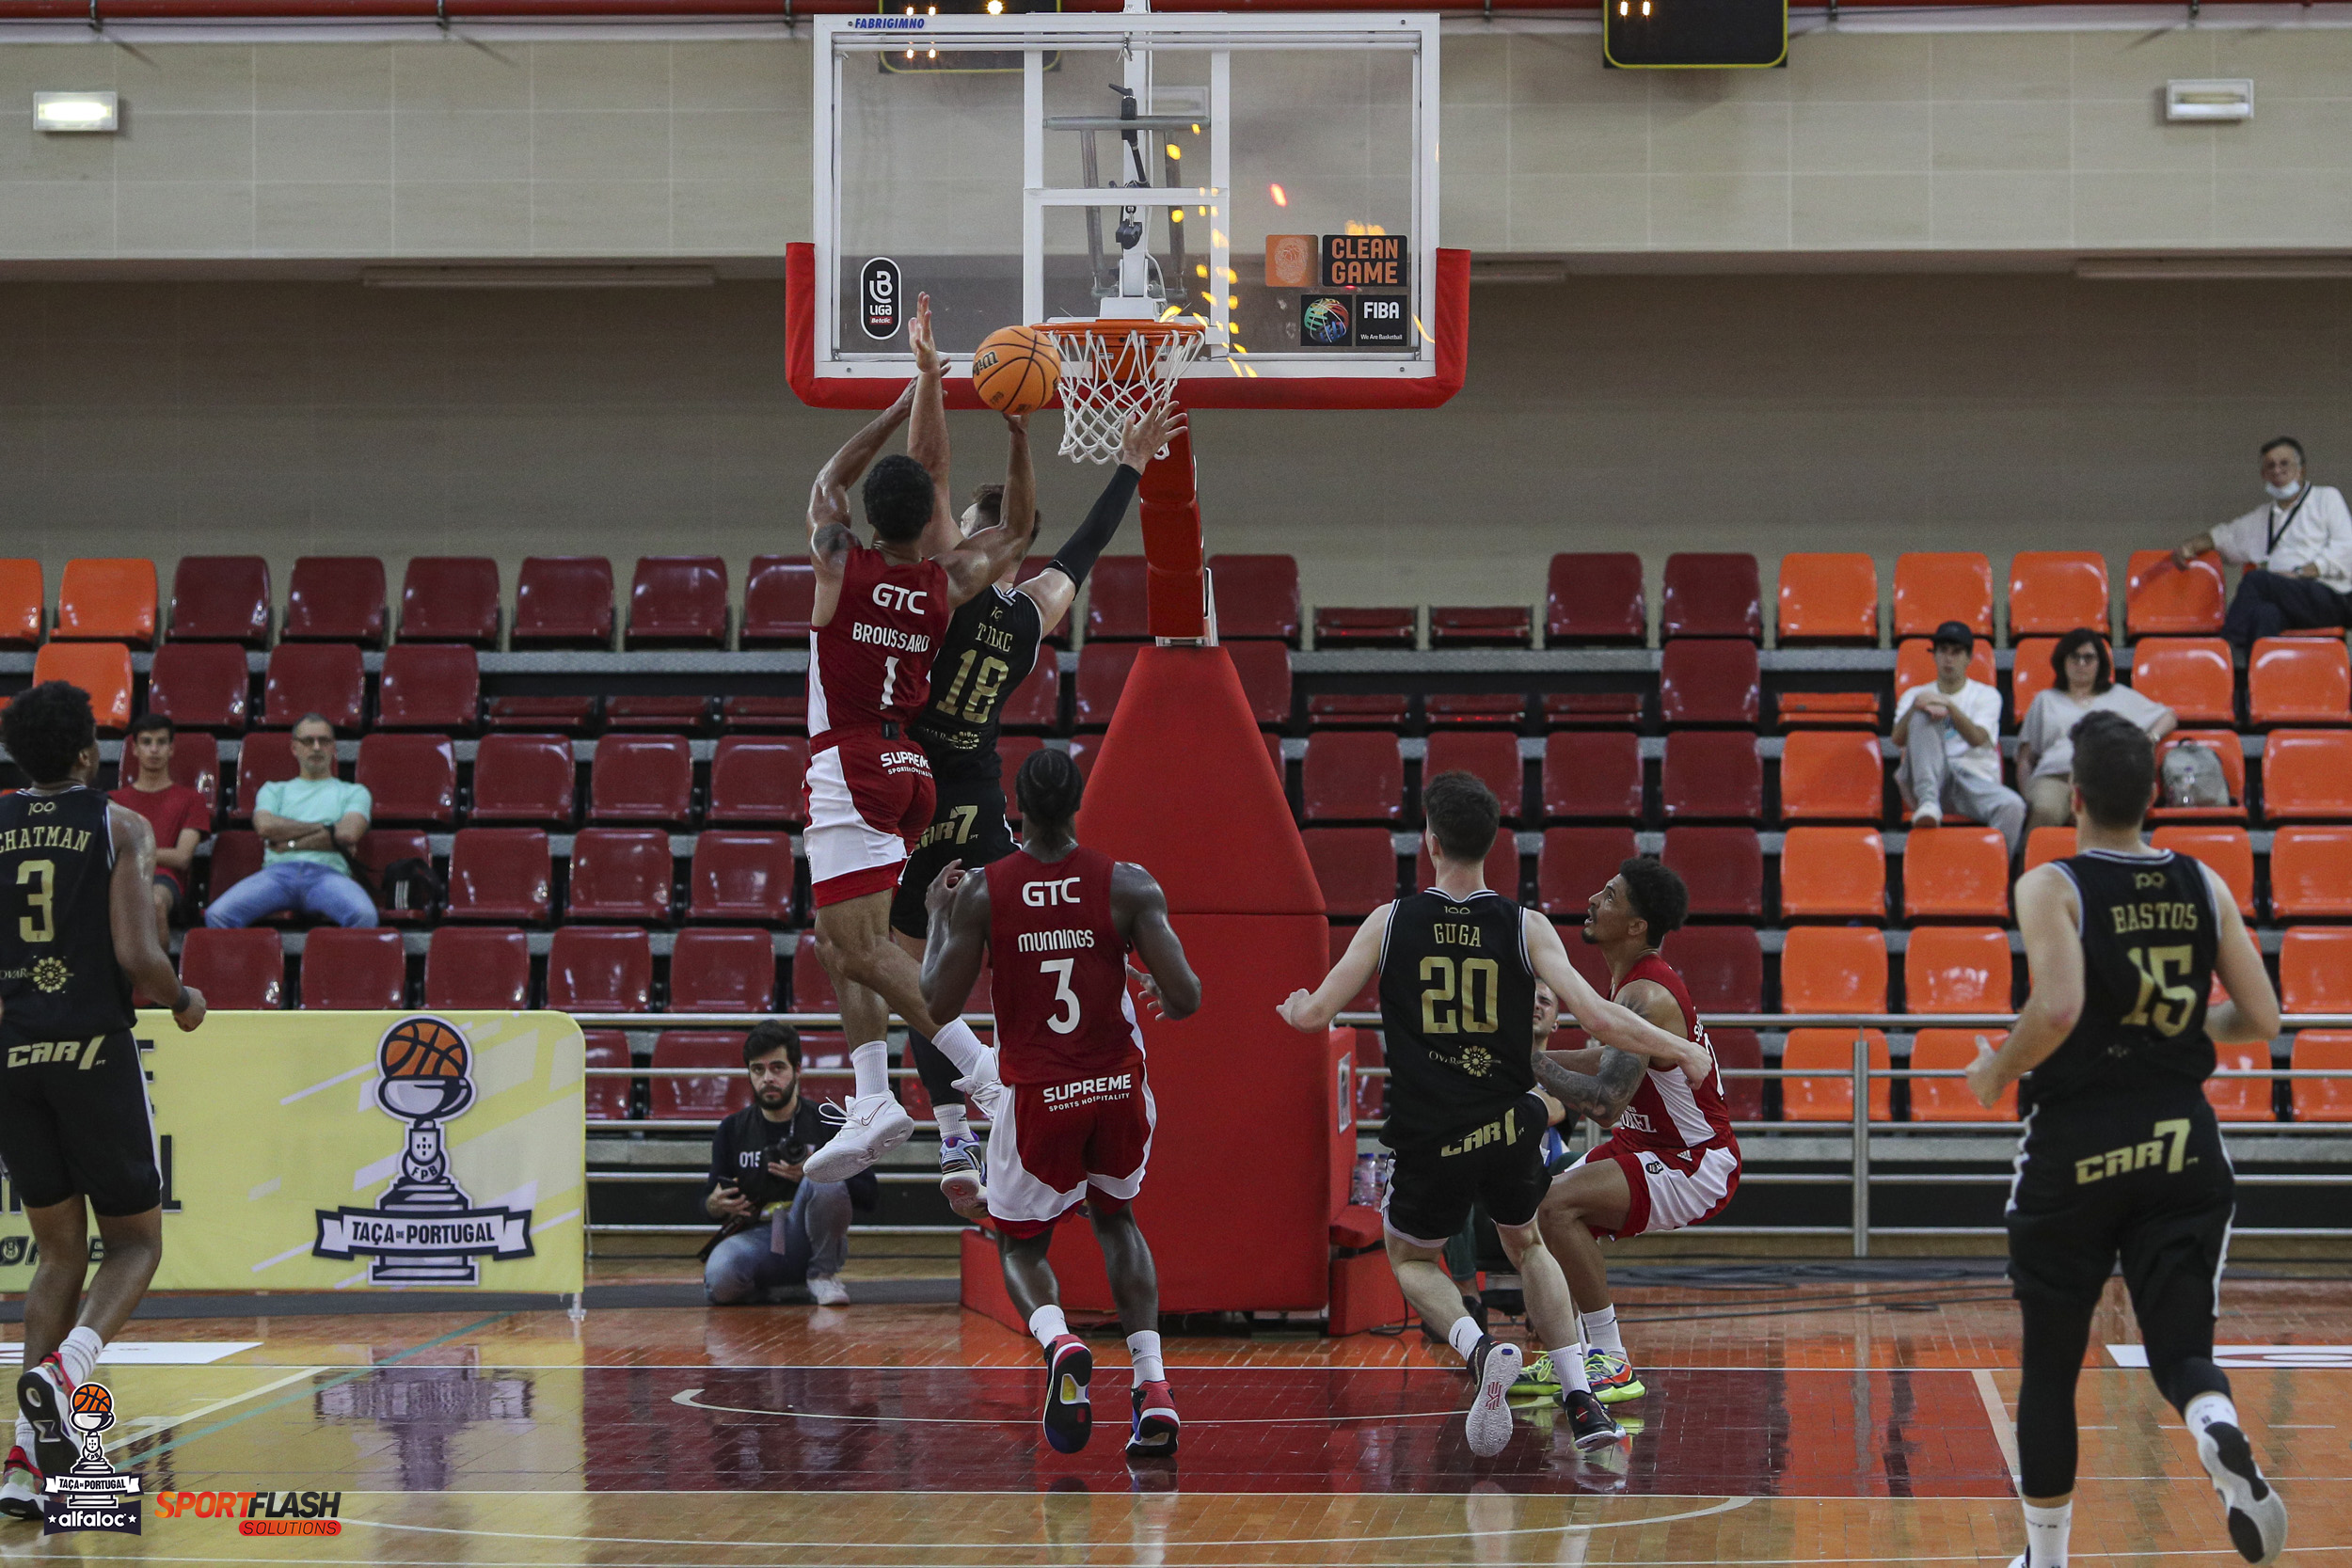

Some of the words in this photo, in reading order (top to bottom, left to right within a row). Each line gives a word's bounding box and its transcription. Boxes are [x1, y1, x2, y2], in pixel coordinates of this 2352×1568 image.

[855, 18, 925, 28] FABRIGIMNO
[1331, 238, 1399, 259] CLEAN
[1331, 261, 1398, 284] GAME
[1363, 301, 1400, 319] FIBA
[872, 582, 928, 615] GTC
[852, 622, 930, 653] BROUSSARD
[880, 656, 899, 710] 1
[935, 649, 1009, 724] 18
[880, 751, 930, 769] SUPREM
[16, 859, 55, 942] 3
[1022, 877, 1081, 907] GTC
[2110, 902, 2199, 935] BASTOS
[1434, 923, 1482, 947] GUGA
[1040, 958, 1081, 1035] 3
[1420, 956, 1499, 1034] 20
[2120, 944, 2198, 1037] 15
[1042, 1073, 1132, 1103] SUPREME
[1048, 1101, 1080, 1113] SPORTS
[1081, 1092, 1130, 1105] HOSPITALITY
[411, 1164, 439, 1180] FPB
[352, 1221, 395, 1245] TAÇA
[396, 1229, 405, 1239] DE
[405, 1222, 496, 1244] PORTUGAL
